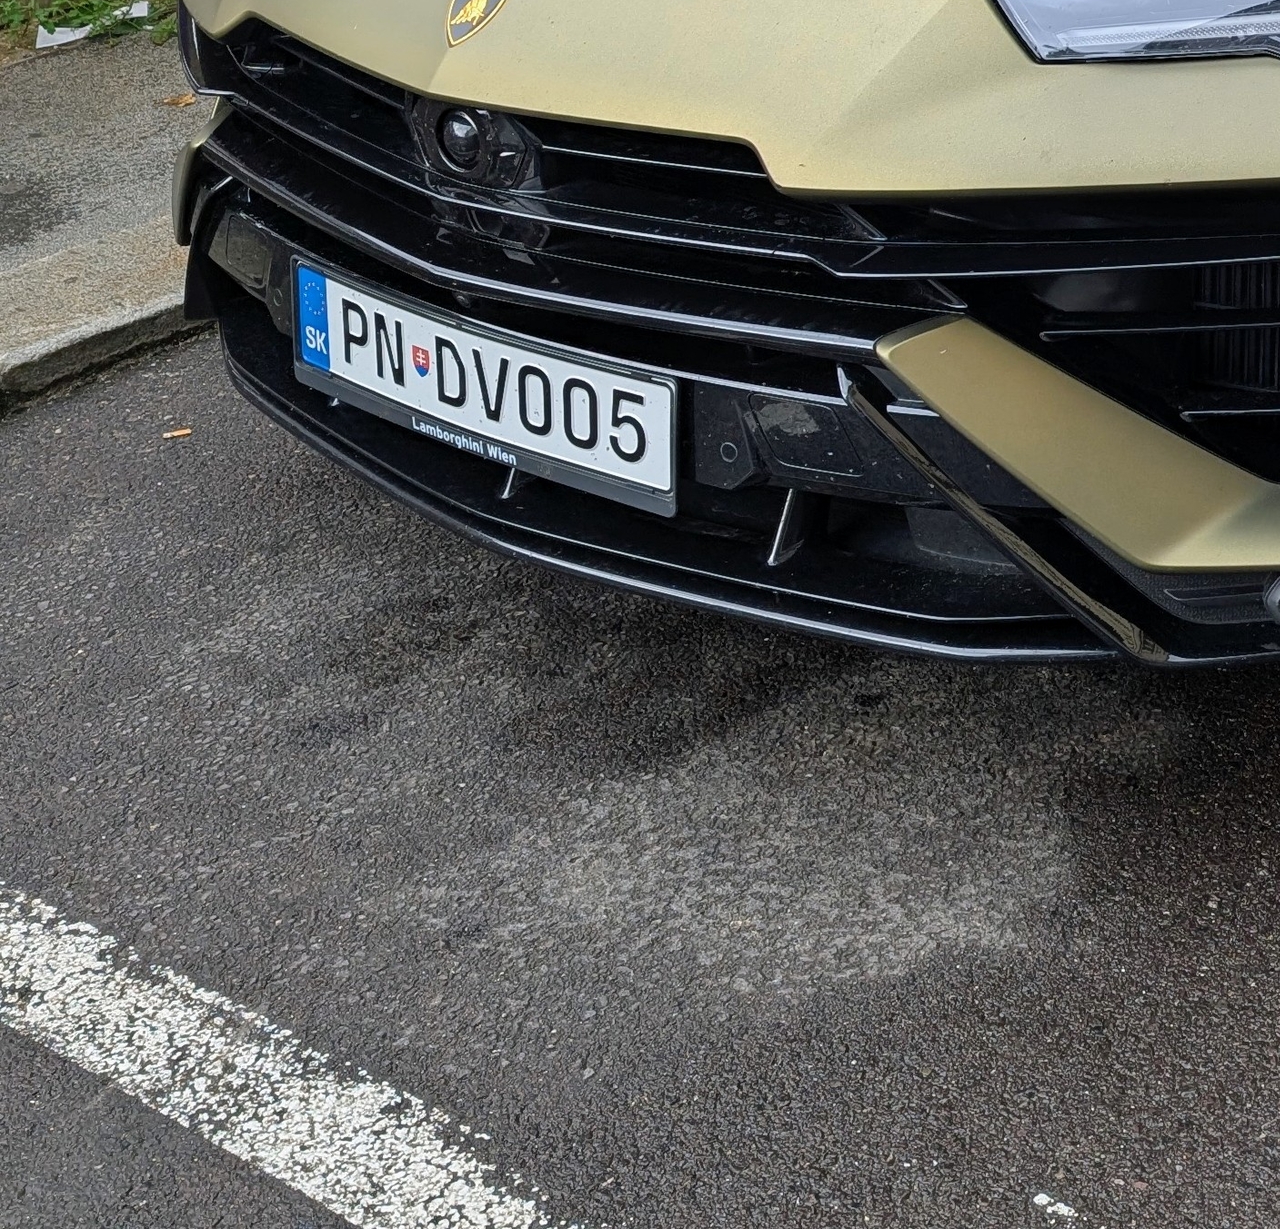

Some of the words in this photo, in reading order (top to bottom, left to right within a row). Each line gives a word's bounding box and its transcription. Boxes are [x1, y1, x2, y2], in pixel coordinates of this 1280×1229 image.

[305, 325, 327, 355] SK
[341, 297, 405, 387] PN
[434, 335, 647, 463] DV005
[411, 416, 484, 456] Lamborghini
[486, 439, 517, 466] Wien
